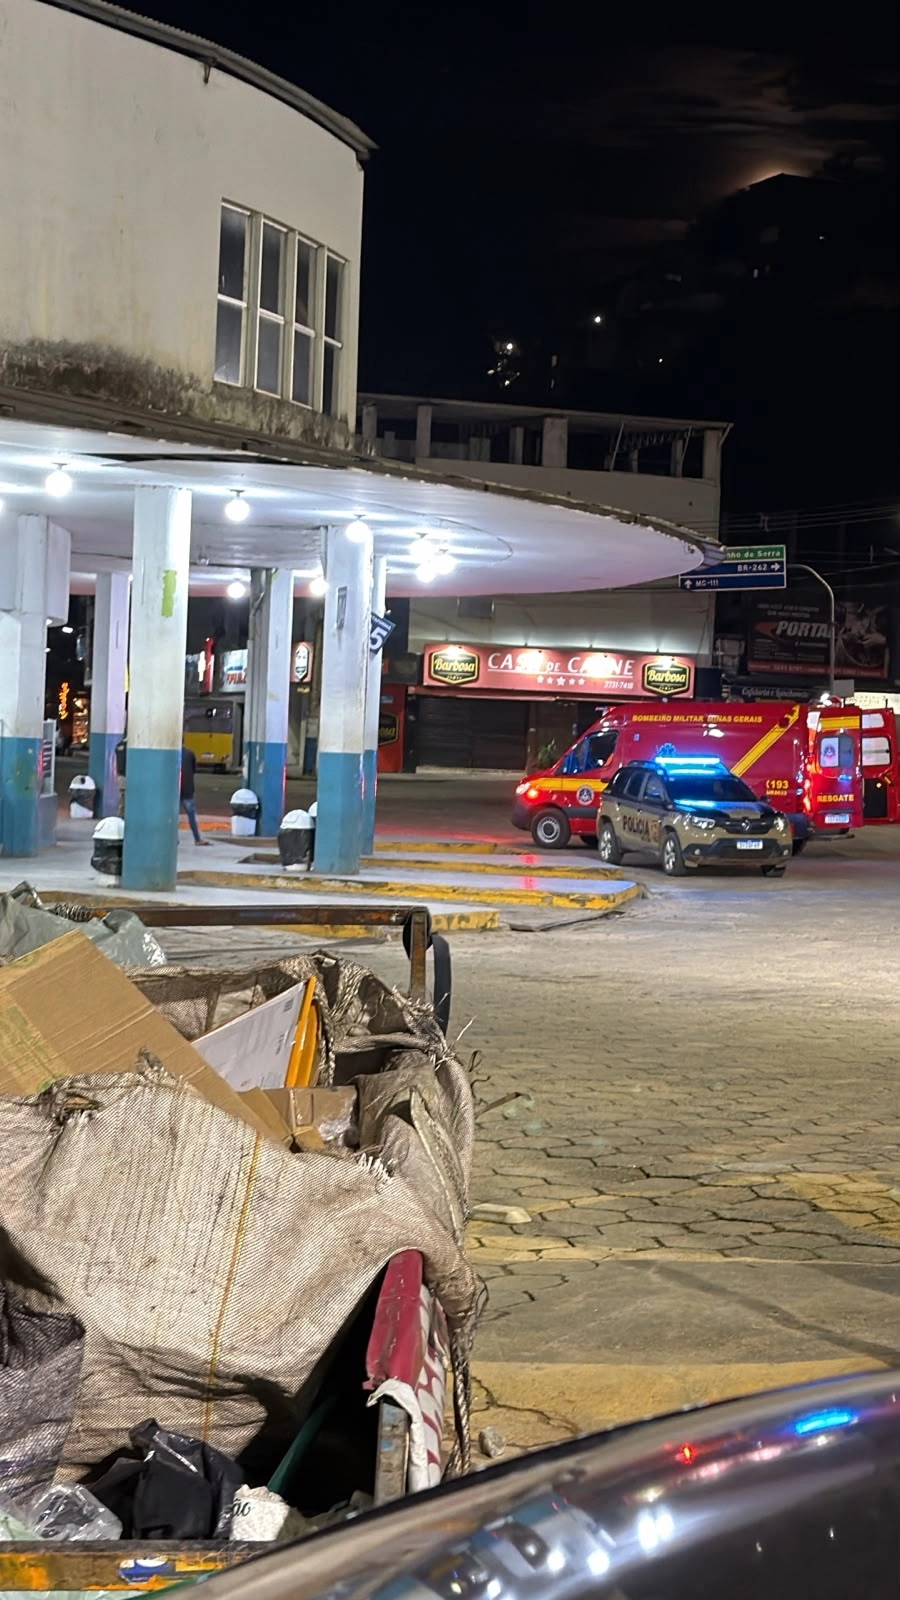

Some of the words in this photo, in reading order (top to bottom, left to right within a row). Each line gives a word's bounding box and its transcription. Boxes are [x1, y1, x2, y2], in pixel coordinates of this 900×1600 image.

[737, 563, 768, 572] BR-262
[369, 626, 388, 650] 5
[434, 658, 475, 672] Barbosa
[647, 669, 686, 683] Barbosa
[632, 714, 672, 722] BOMBEIRO
[707, 715, 732, 723] MINAS
[733, 715, 763, 723] GERAIS
[770, 779, 789, 789] 193
[816, 793, 855, 803] RESGATE
